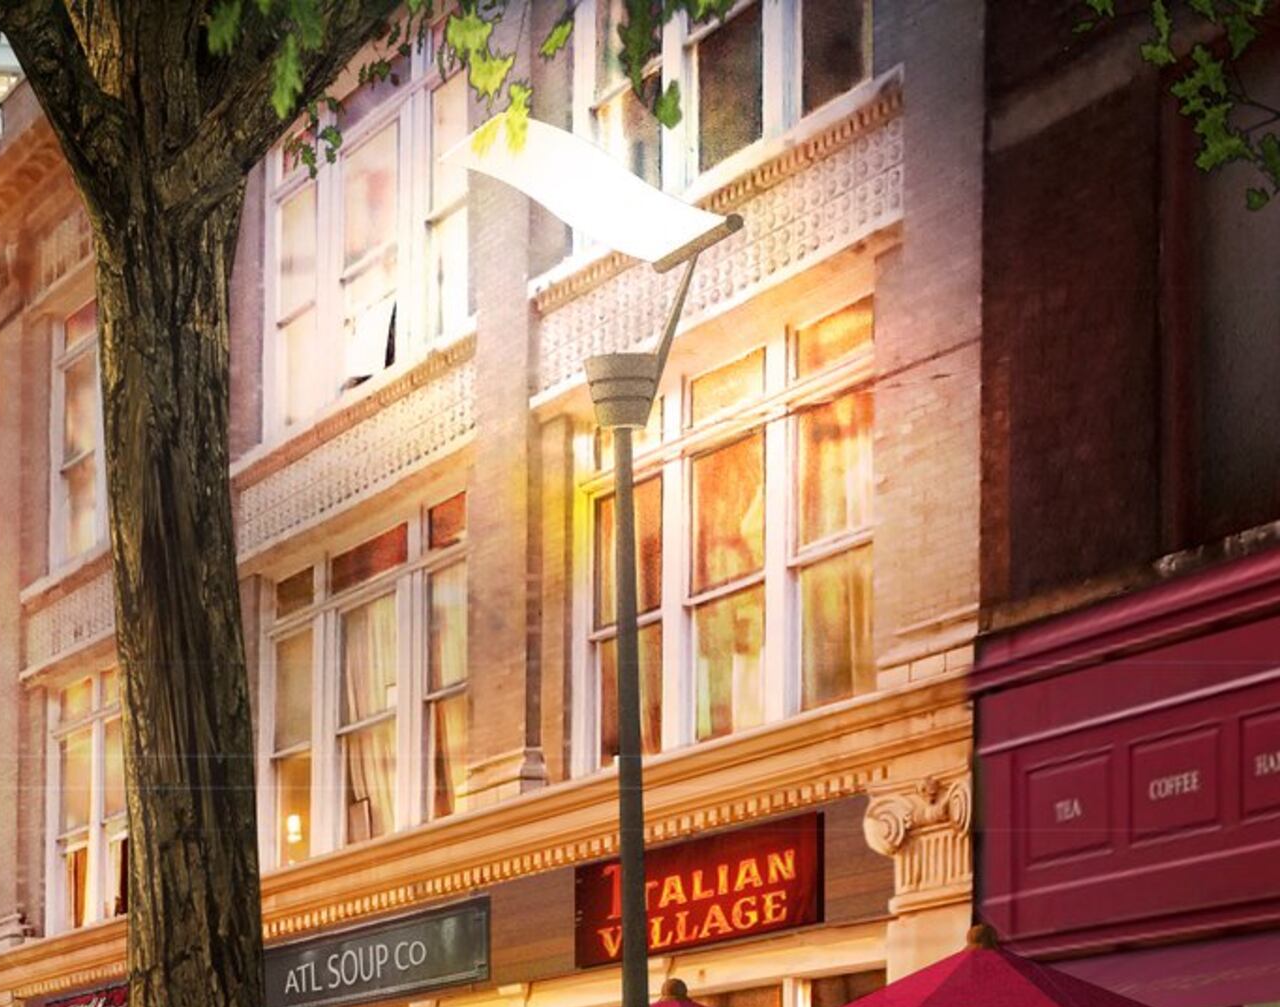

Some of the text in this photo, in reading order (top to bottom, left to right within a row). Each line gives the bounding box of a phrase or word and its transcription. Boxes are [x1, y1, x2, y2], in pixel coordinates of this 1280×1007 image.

[1148, 770, 1200, 800] COFFEE
[1054, 799, 1082, 823] TEA
[597, 890, 788, 958] VLLAGE
[285, 940, 427, 994] ATL SOUP CO
